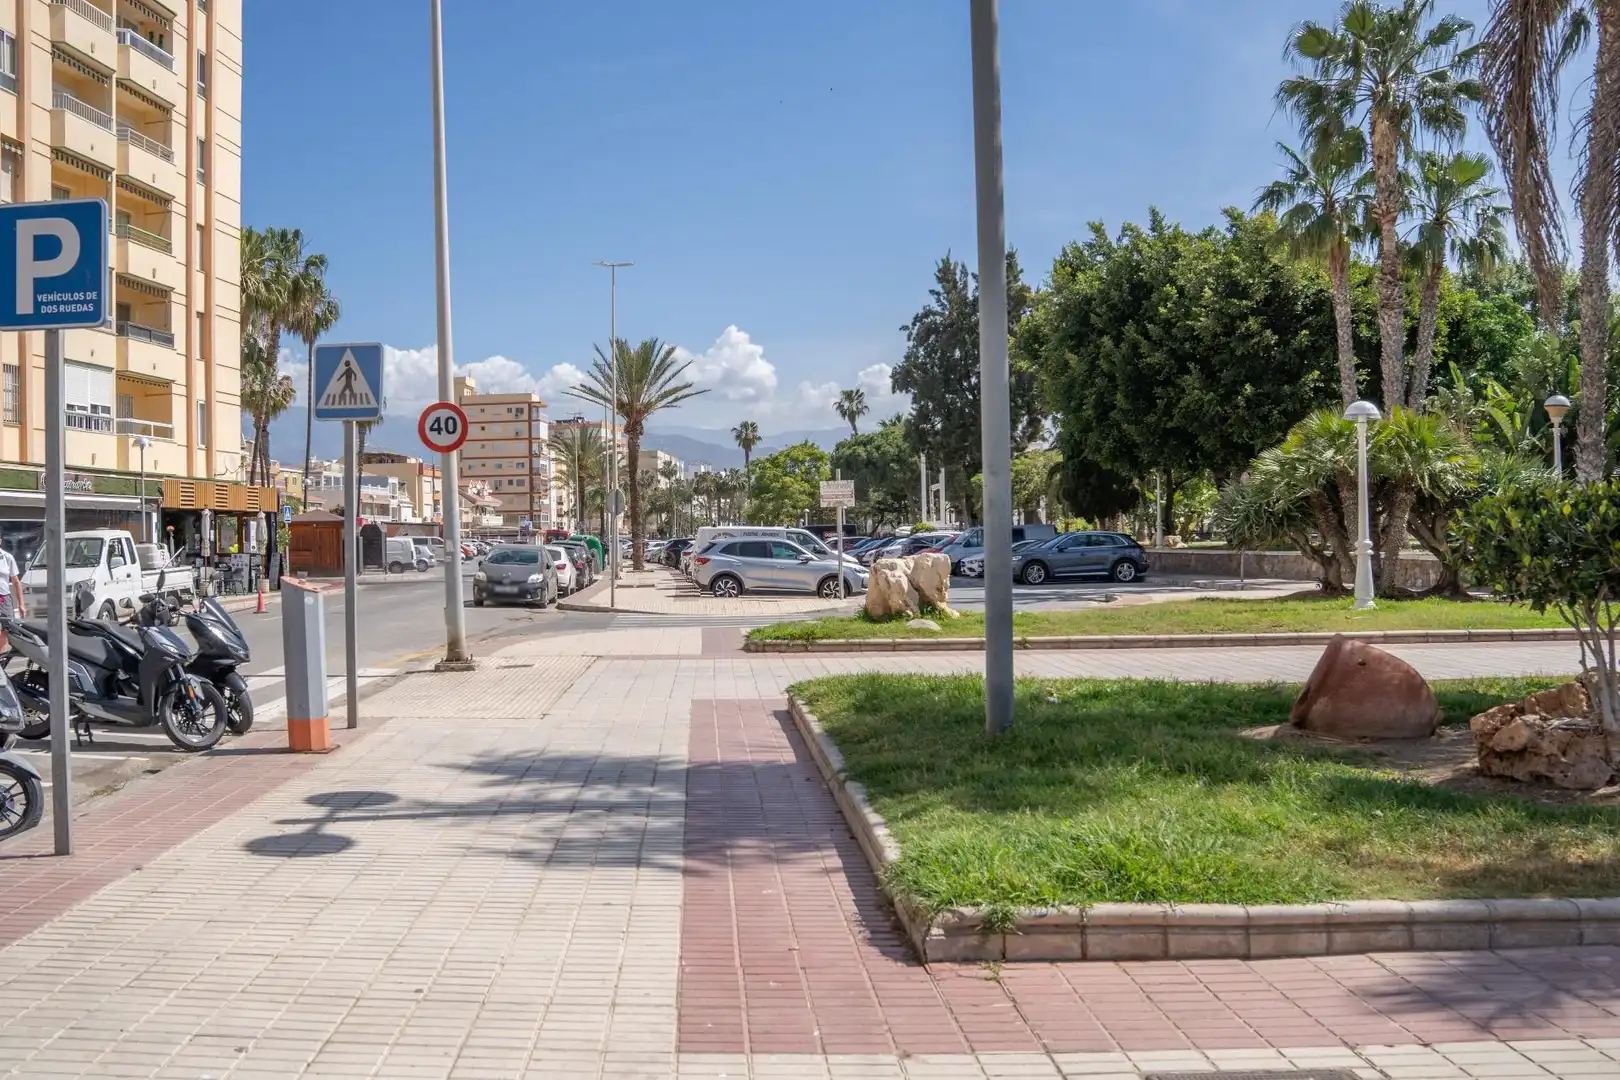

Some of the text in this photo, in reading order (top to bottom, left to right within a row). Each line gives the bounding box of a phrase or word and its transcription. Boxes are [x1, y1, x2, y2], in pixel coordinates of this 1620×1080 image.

[16, 217, 80, 315] P
[37, 291, 98, 302] VEHÍCULOS DE
[41, 303, 94, 314] DOS RUEDAS
[429, 416, 457, 435] 40
